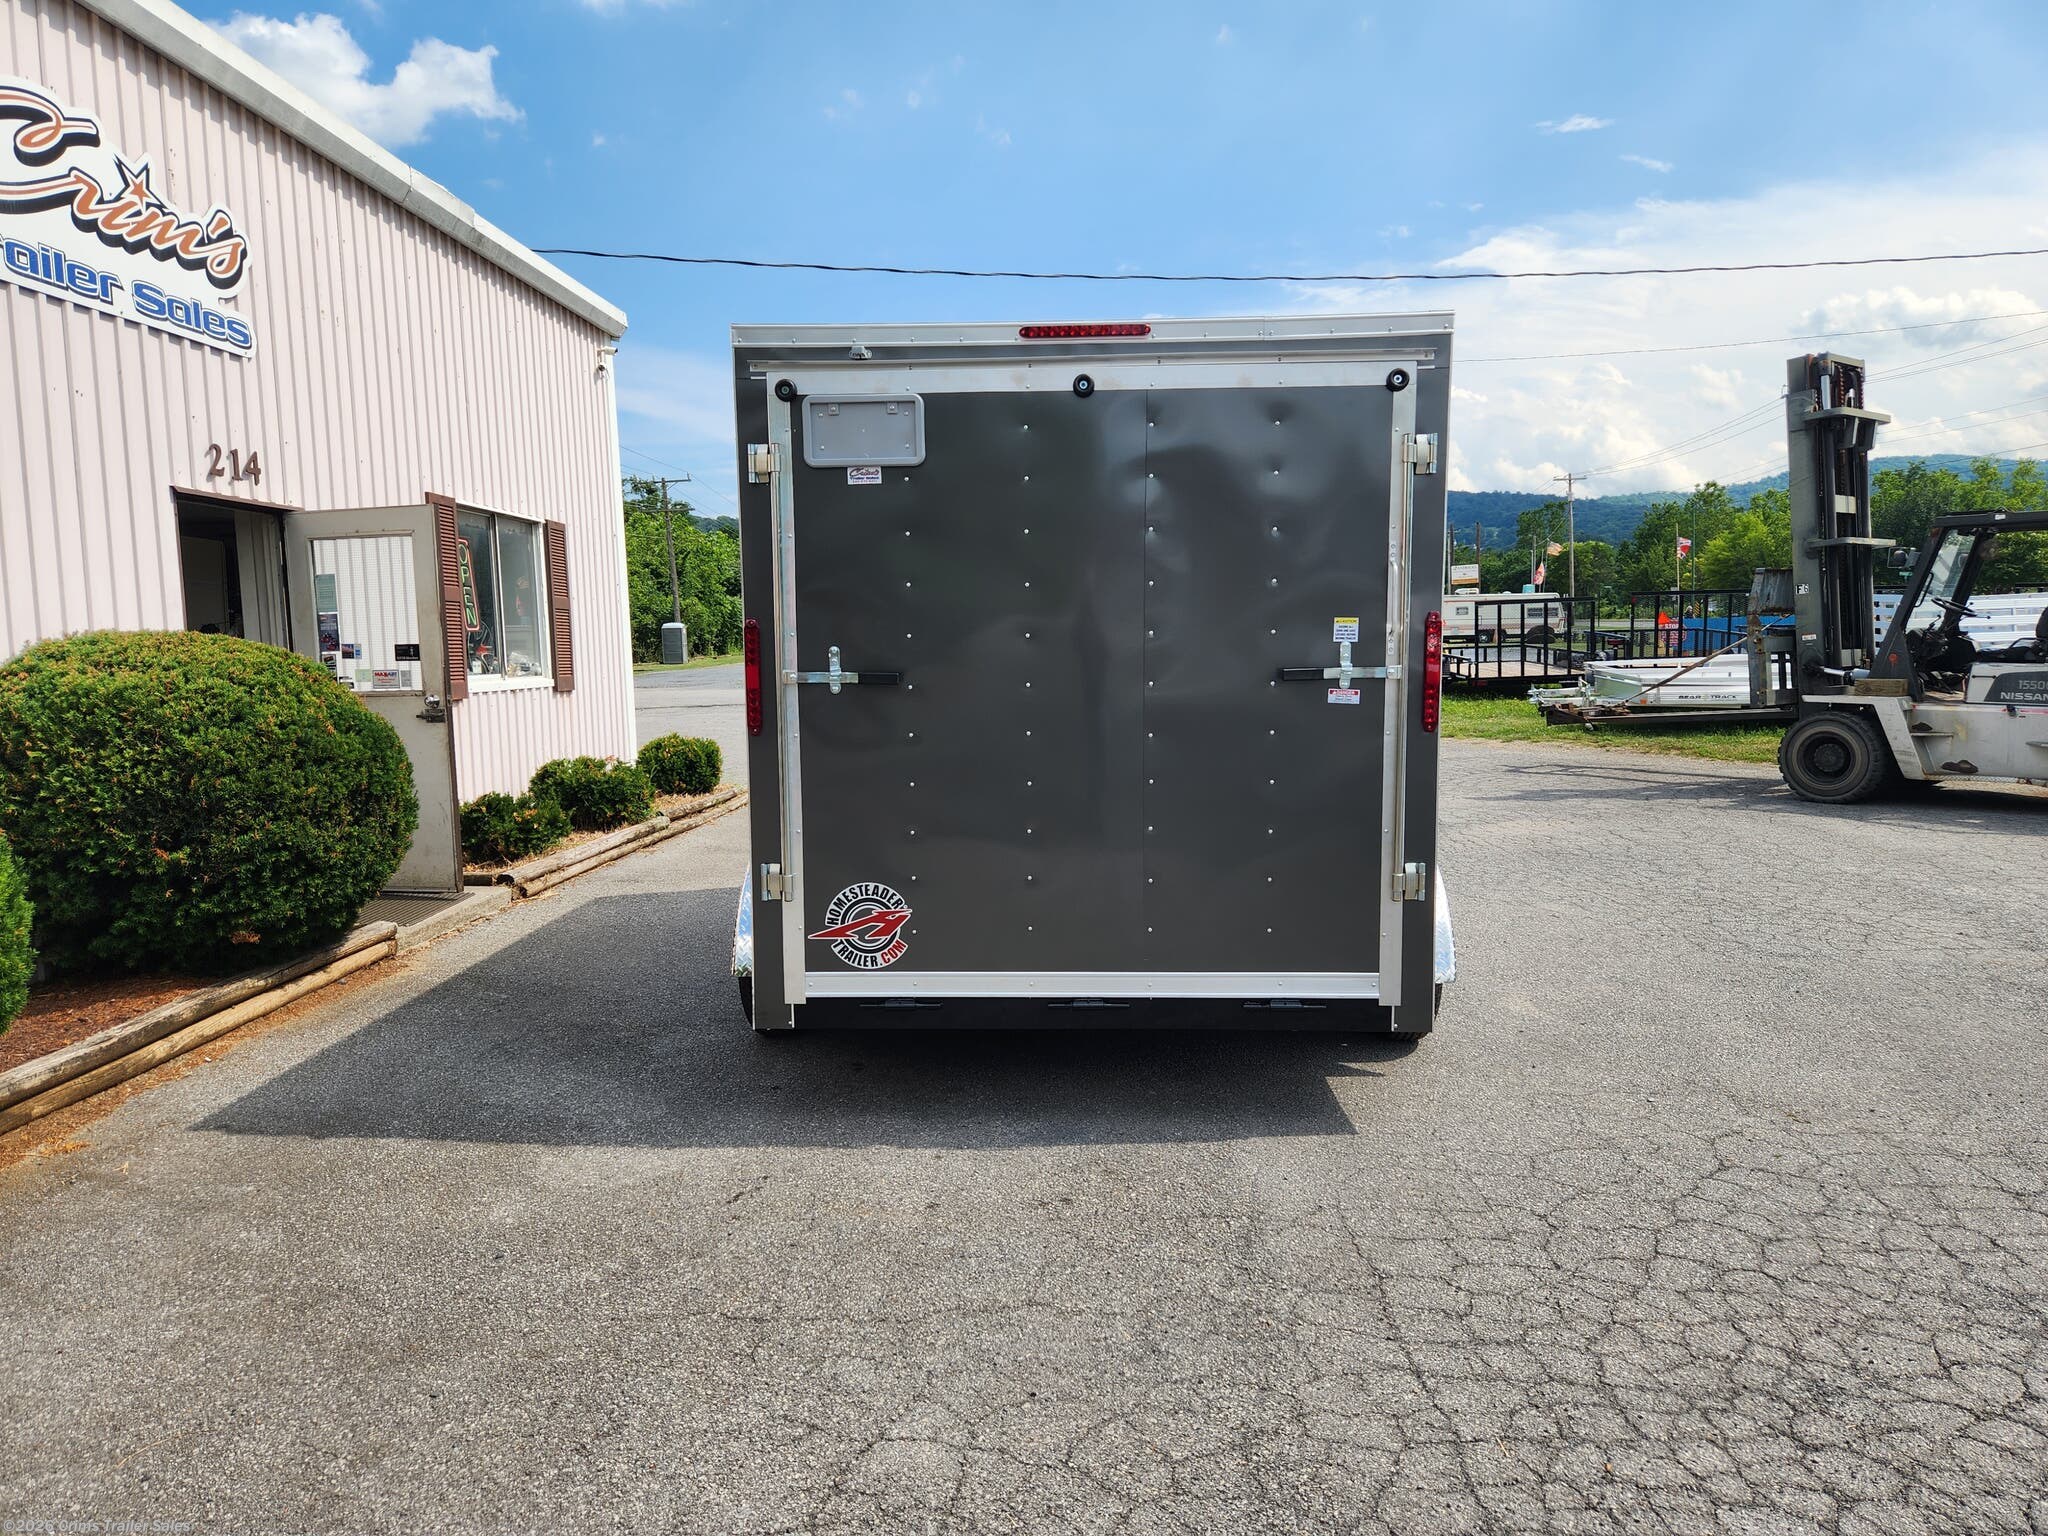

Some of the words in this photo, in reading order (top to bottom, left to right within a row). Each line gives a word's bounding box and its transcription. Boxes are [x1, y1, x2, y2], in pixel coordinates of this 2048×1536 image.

[132, 280, 252, 349] Sales
[208, 443, 262, 486] 214
[458, 543, 477, 626] OPEN
[2019, 680, 2048, 690] 1550
[826, 883, 905, 926] HOMESTEADER
